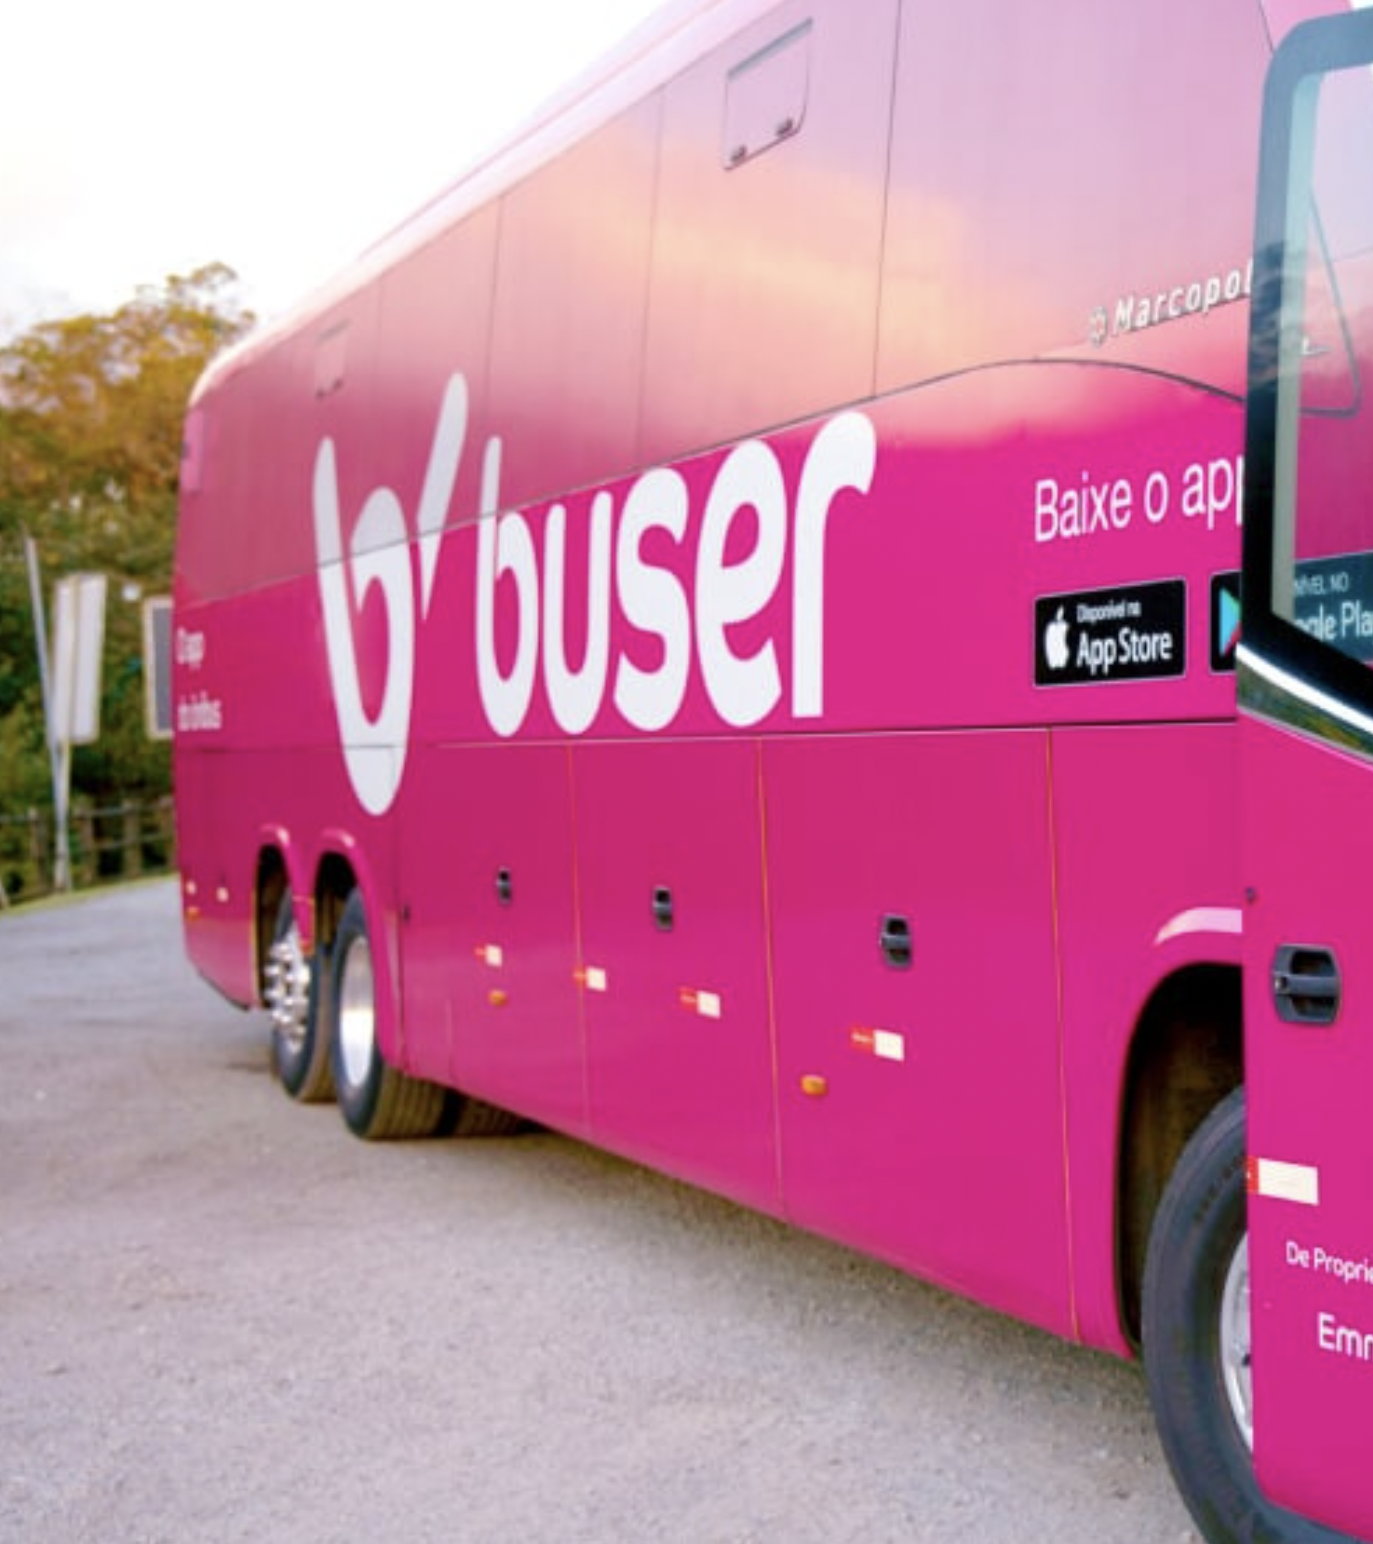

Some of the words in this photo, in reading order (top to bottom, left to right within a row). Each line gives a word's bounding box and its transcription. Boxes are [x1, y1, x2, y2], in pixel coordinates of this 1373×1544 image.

[1035, 470, 1132, 542] Baixe
[1144, 471, 1169, 523] o
[476, 411, 876, 737] buser
[1077, 631, 1118, 675] App
[1118, 626, 1173, 664] Store
[1286, 1240, 1310, 1269] De
